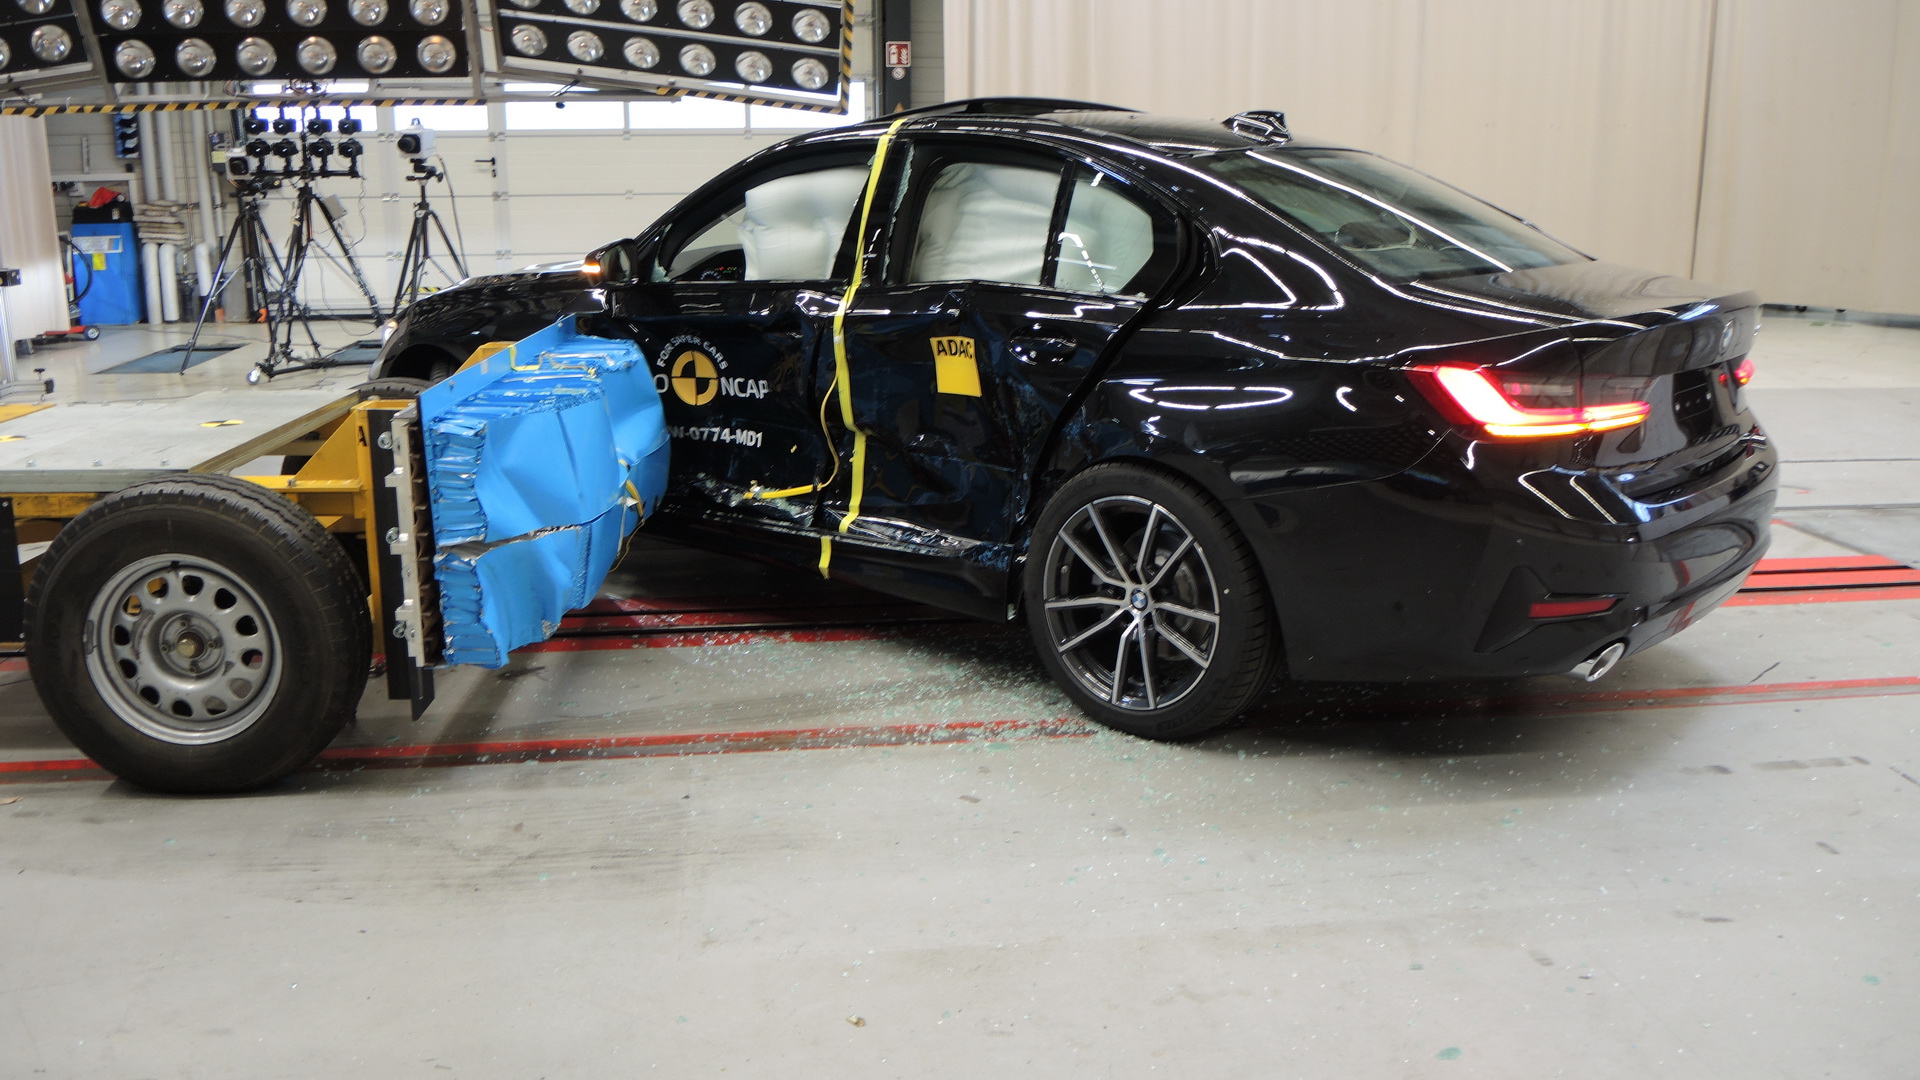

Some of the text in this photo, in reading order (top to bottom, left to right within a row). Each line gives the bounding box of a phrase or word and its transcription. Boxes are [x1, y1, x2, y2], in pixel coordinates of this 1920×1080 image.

[656, 335, 728, 369] FOR SAFER CARS
[937, 339, 973, 359] ADAC
[721, 376, 769, 399] NCAP
